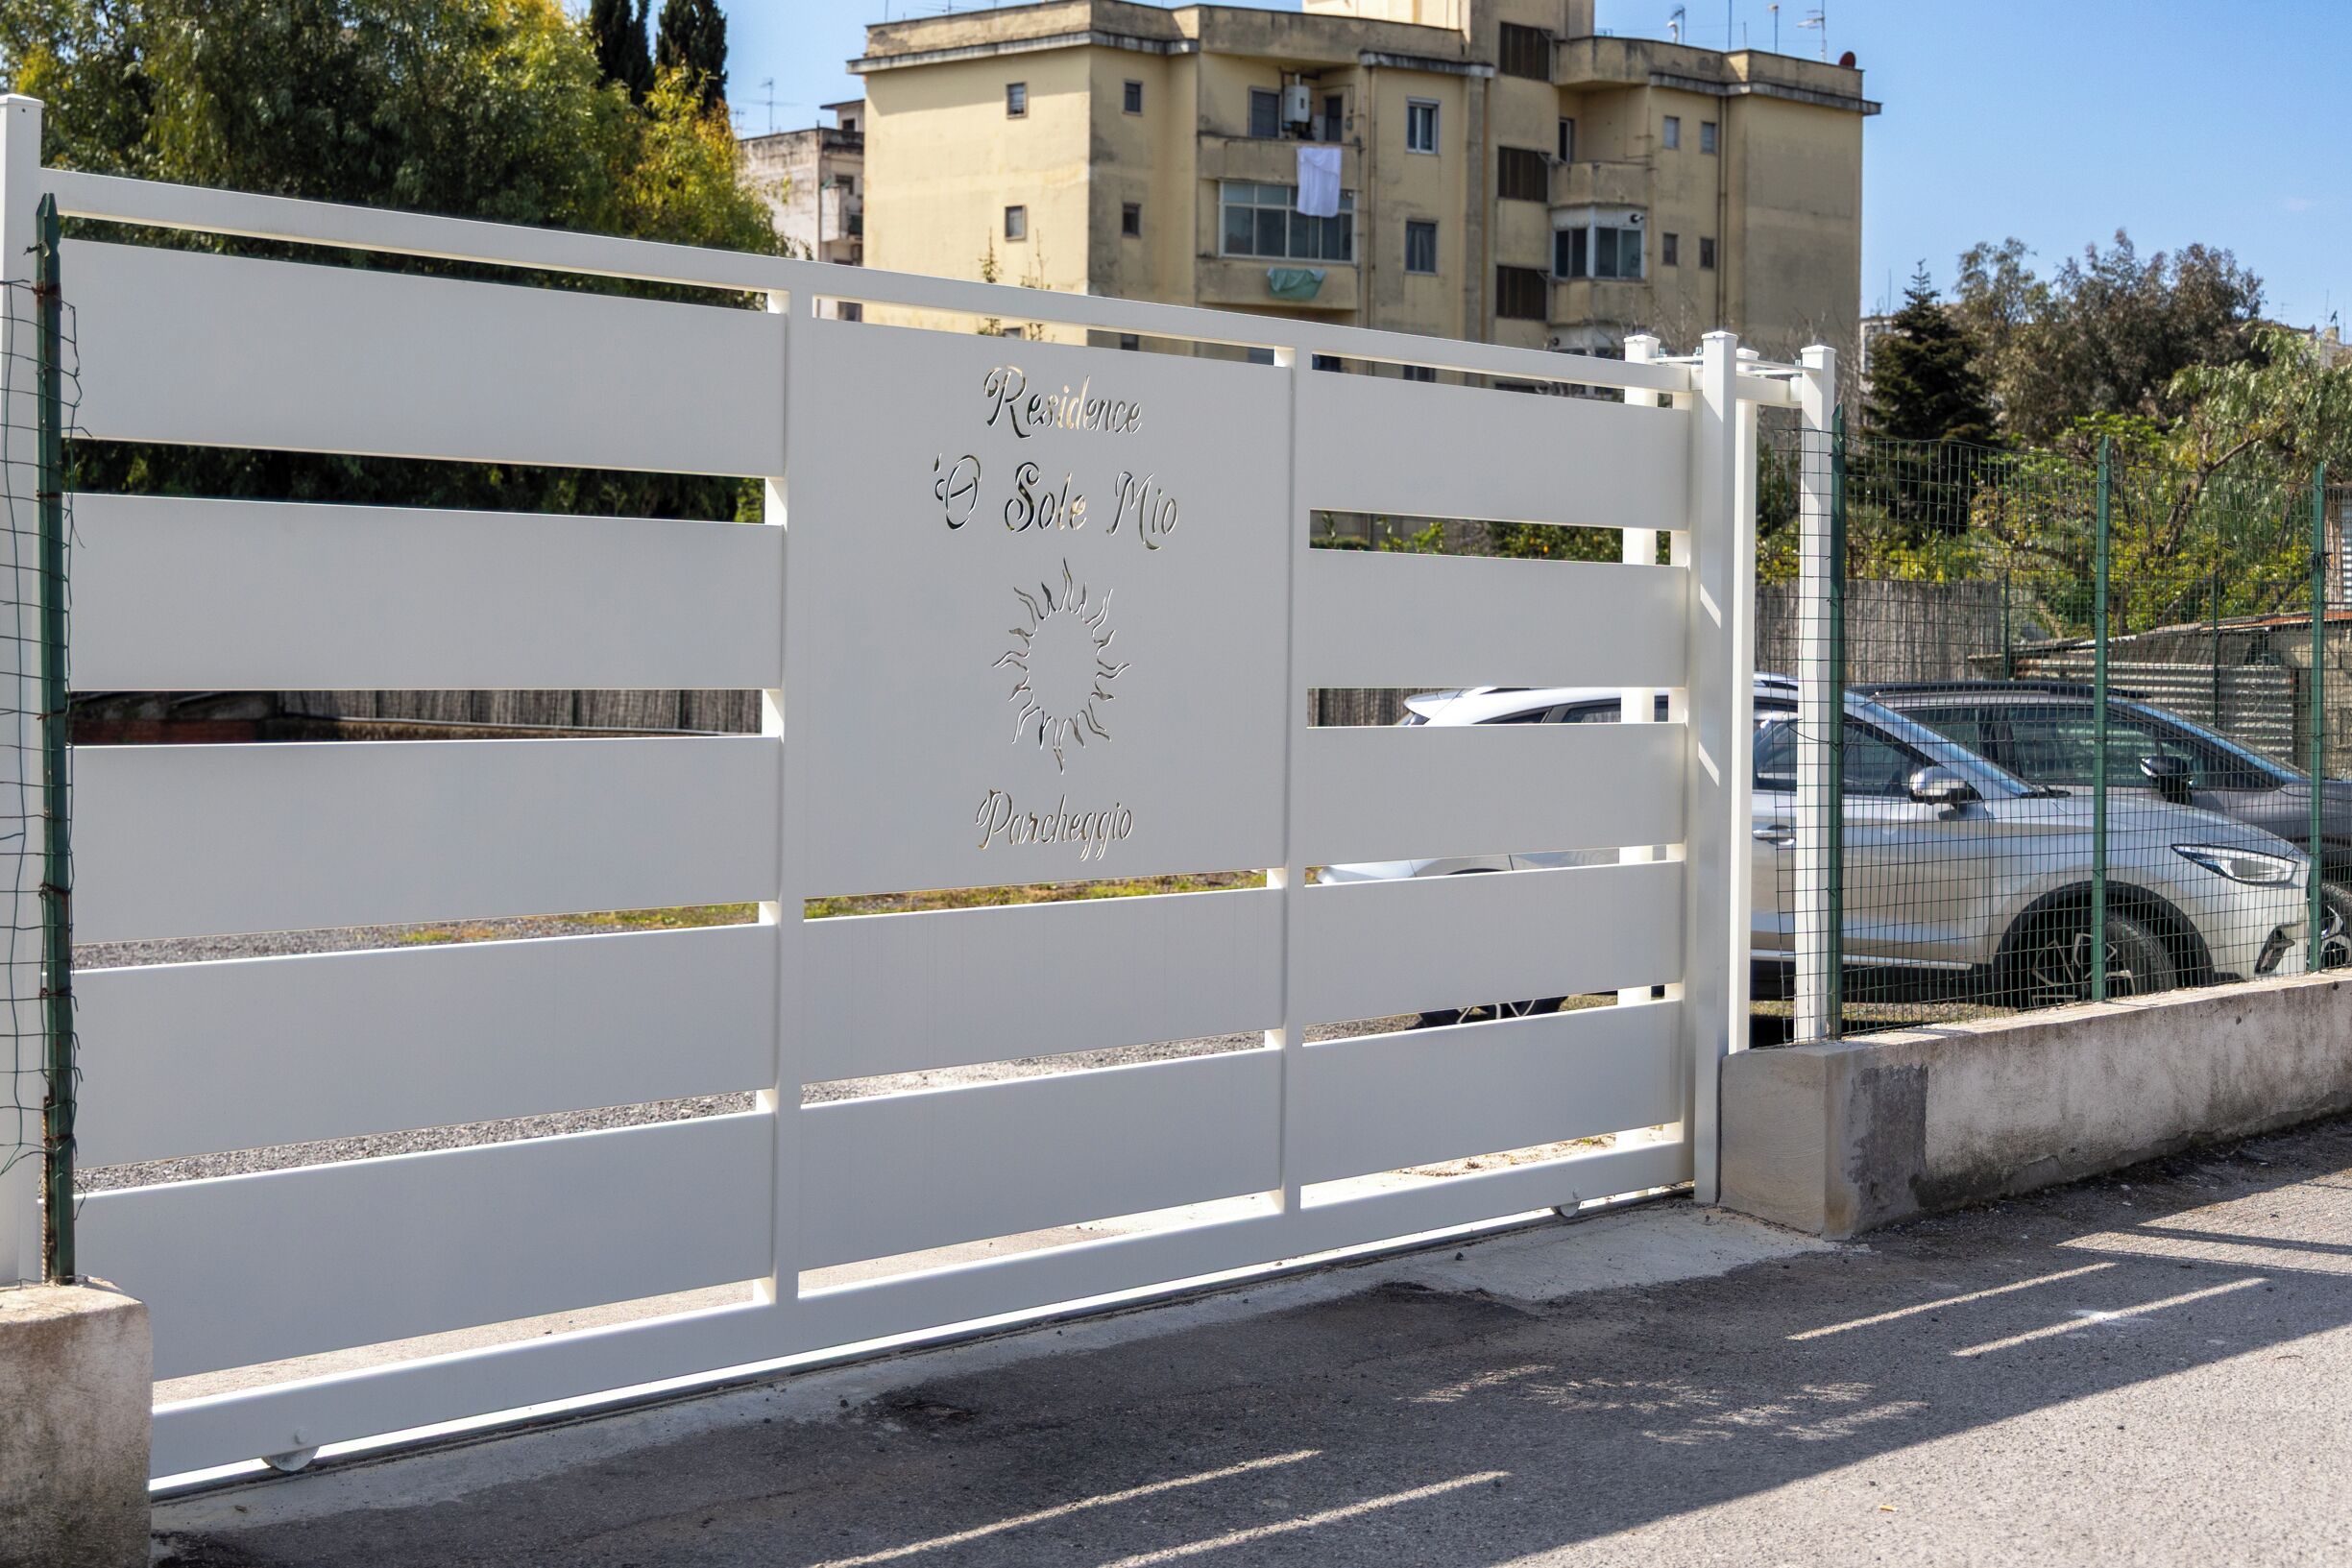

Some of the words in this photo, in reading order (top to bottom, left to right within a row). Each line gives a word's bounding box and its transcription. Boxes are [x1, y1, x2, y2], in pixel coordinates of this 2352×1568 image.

[984, 364, 1143, 438] Residence
[1005, 461, 1087, 533] Sole
[1106, 470, 1177, 550] Mio
[976, 789, 1133, 861] Parcheggio
